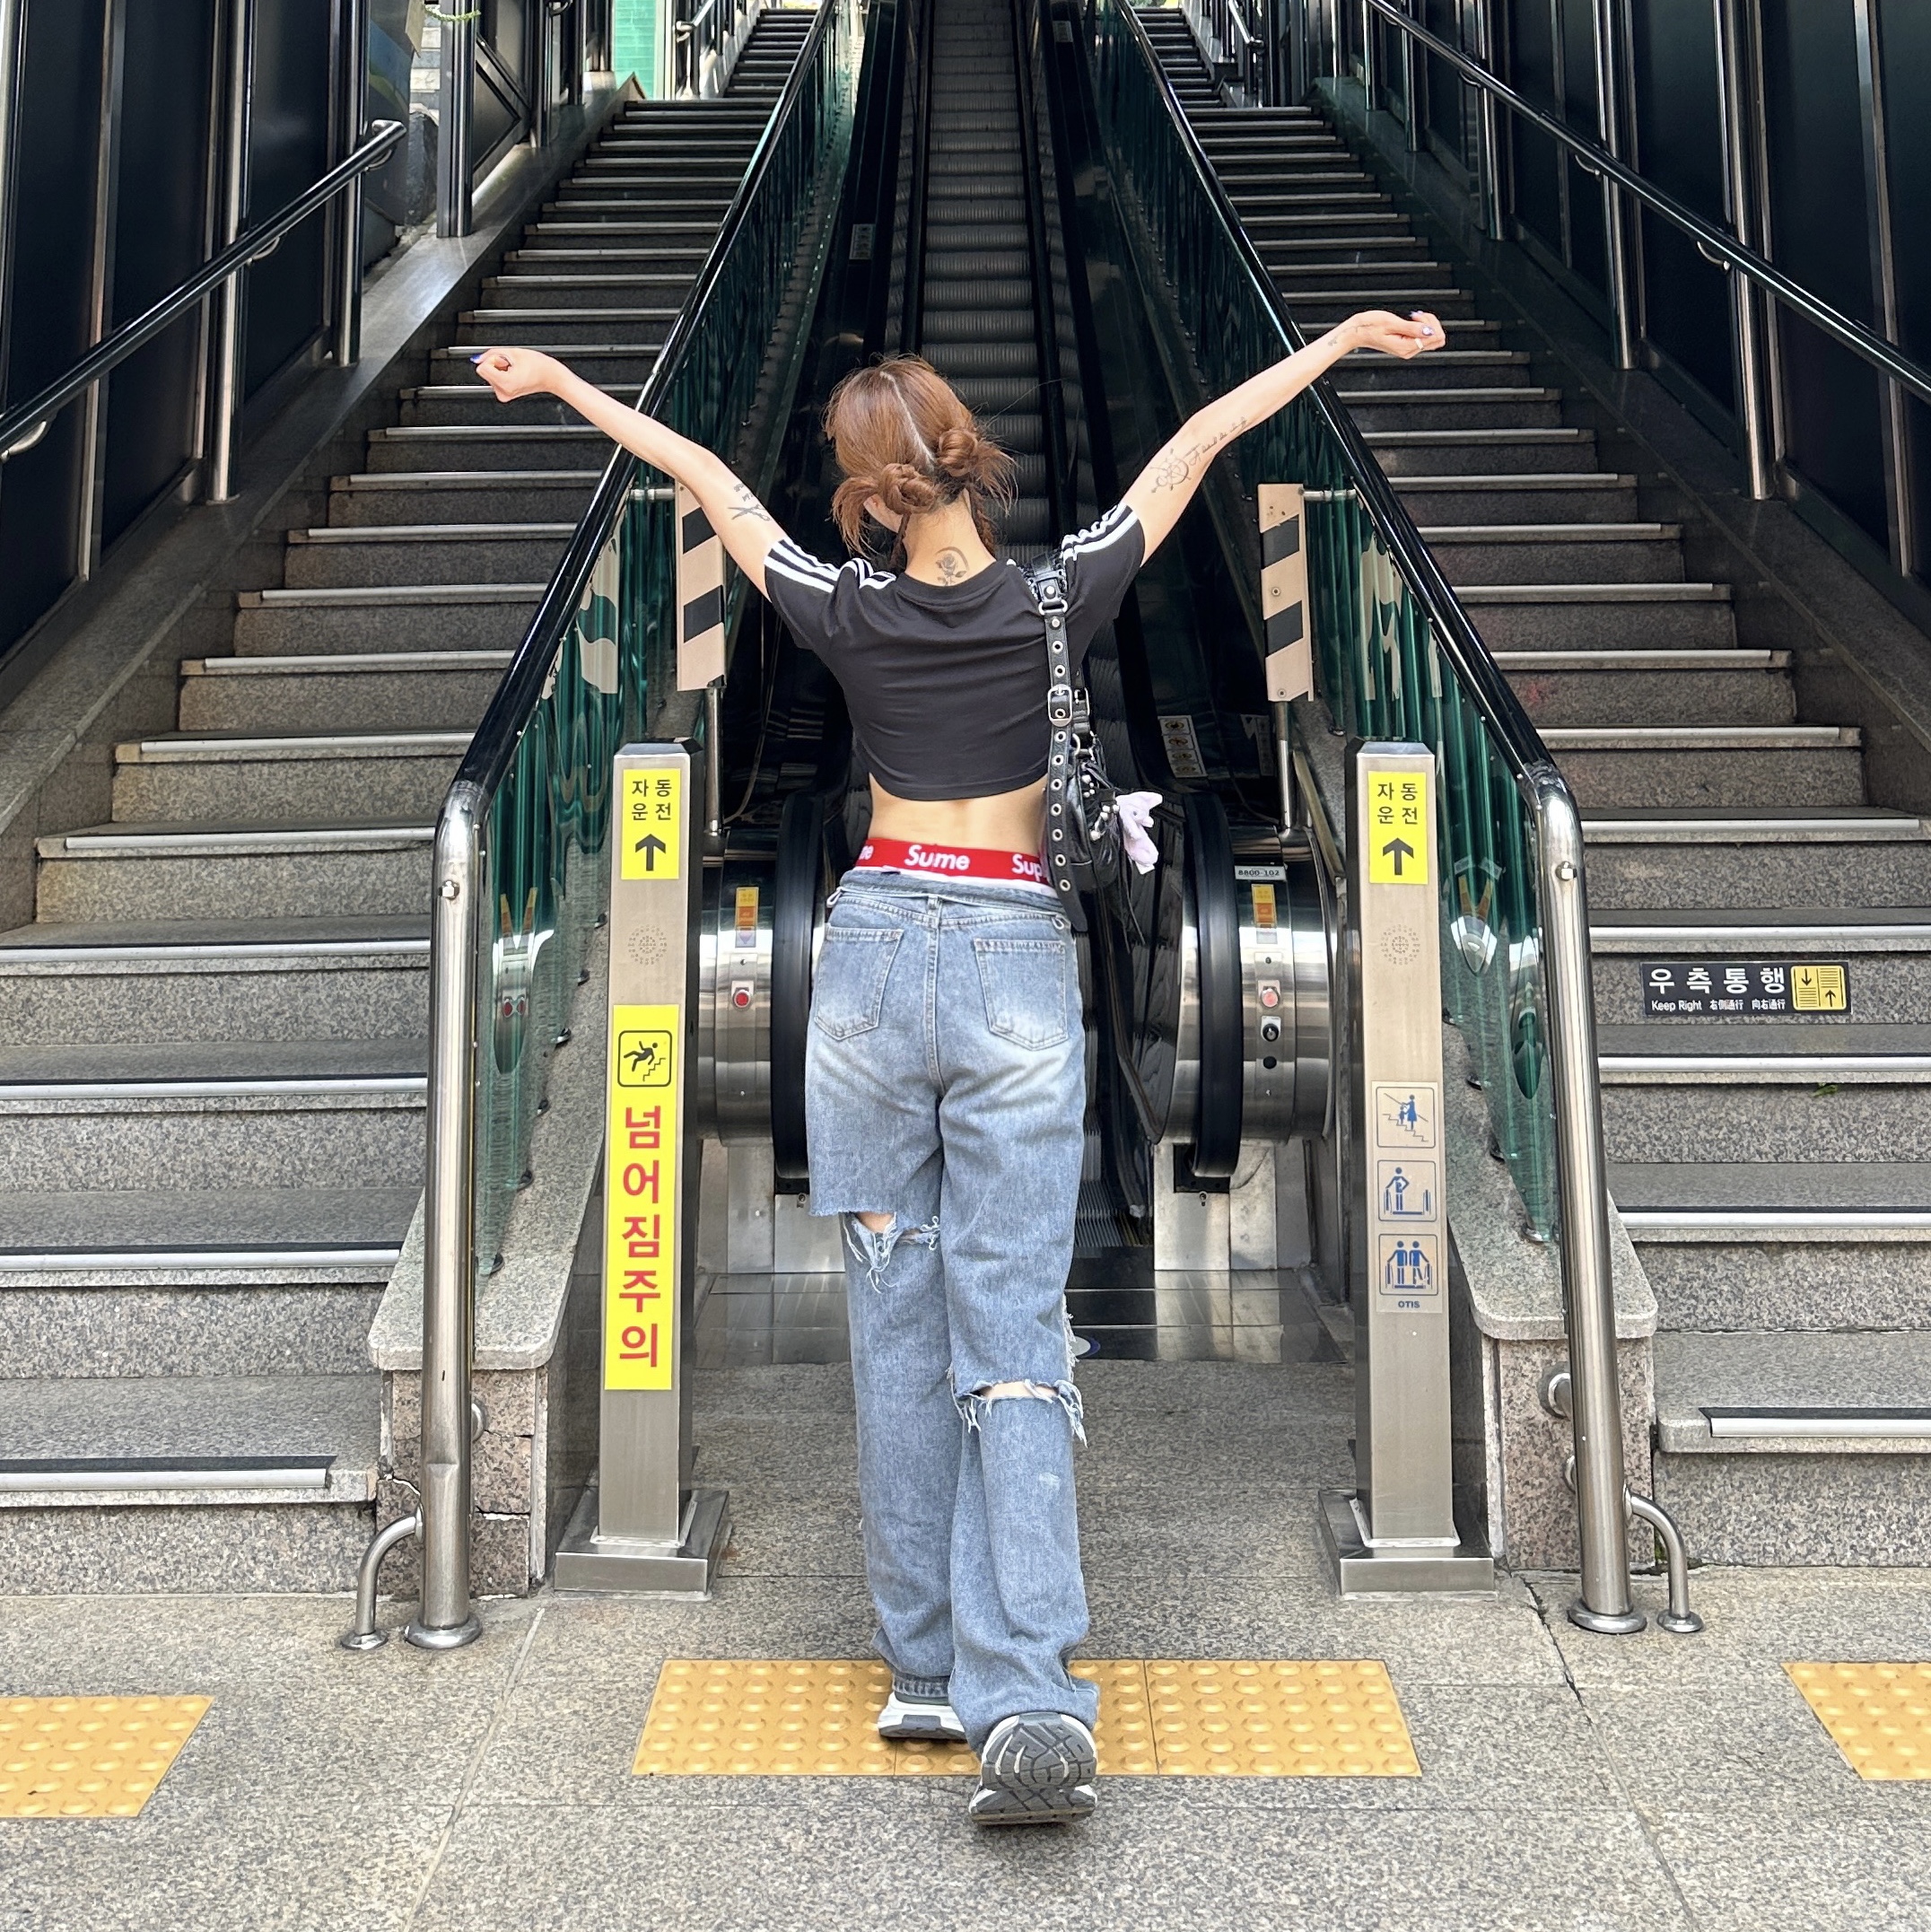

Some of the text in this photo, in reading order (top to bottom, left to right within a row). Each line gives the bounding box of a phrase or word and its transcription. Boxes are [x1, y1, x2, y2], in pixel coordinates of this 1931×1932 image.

[631, 778, 672, 798] 자동
[1376, 782, 1418, 801] 자동
[631, 802, 671, 821] 운전
[1376, 806, 1418, 826] 운전
[1648, 966, 1786, 994] 우측통행
[1651, 999, 1676, 1012] Keep
[1678, 999, 1703, 1012] Right
[1398, 1300, 1420, 1308] OTIS
